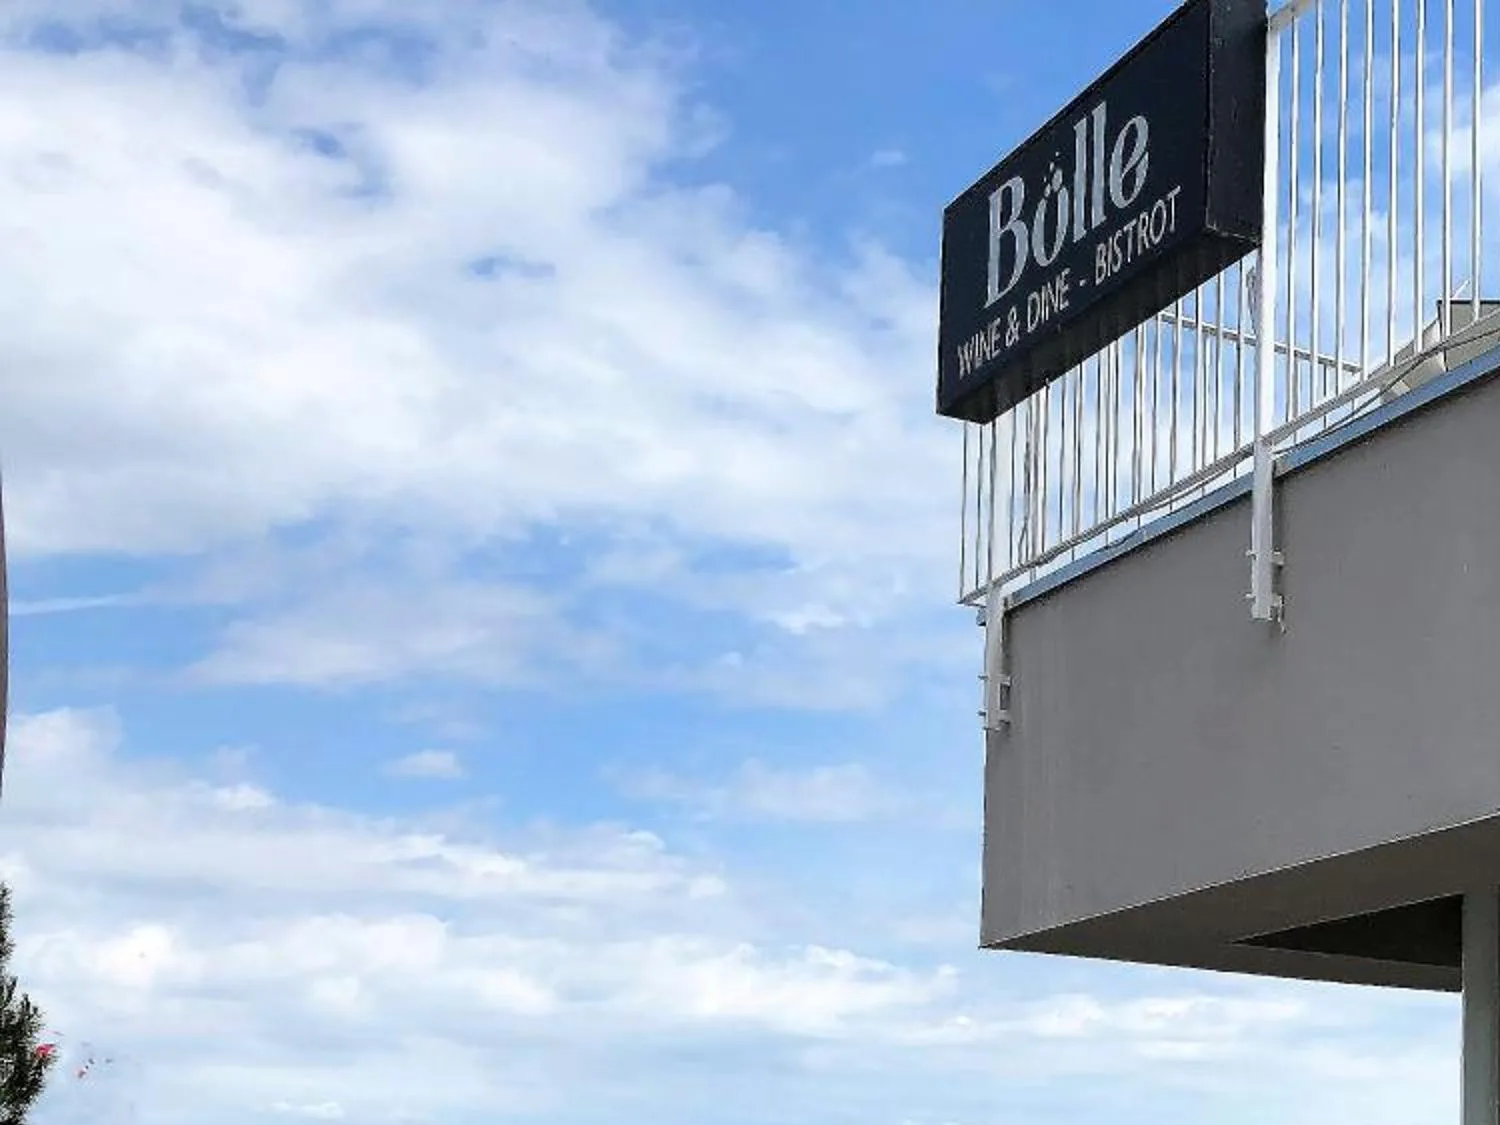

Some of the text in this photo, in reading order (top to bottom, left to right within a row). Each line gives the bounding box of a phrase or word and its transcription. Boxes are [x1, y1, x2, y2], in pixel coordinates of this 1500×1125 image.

[958, 317, 1001, 381] WINE
[1005, 306, 1021, 346] &
[1027, 268, 1071, 334] DINE
[1095, 185, 1182, 287] BISTROT
